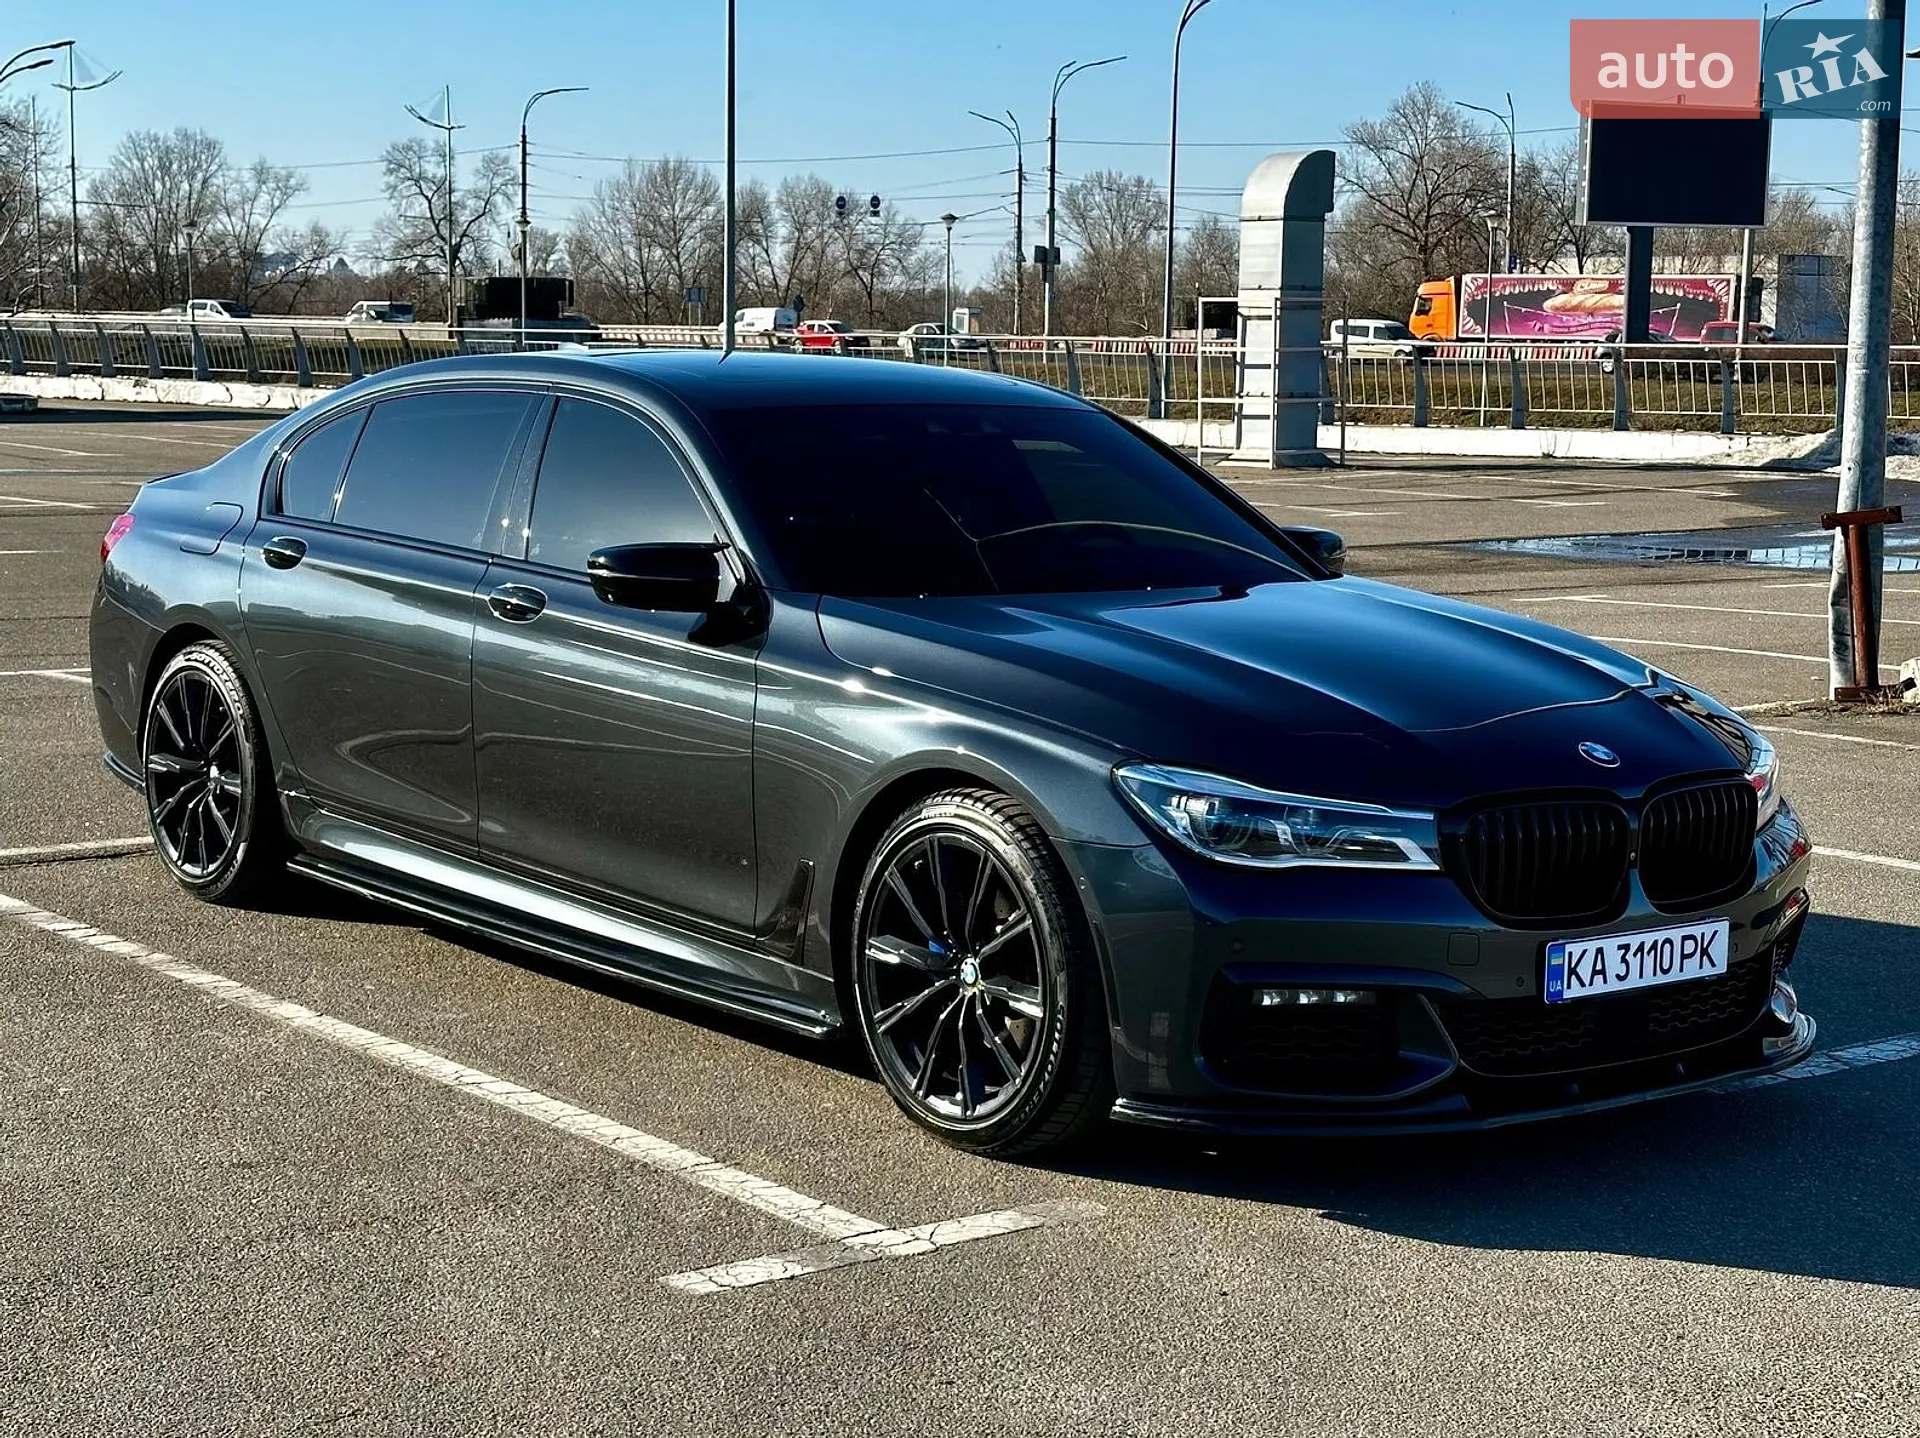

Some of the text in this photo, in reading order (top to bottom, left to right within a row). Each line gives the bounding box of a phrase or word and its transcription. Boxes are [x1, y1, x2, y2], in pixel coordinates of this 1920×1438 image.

[1566, 929, 1720, 990] KA 3110 PK
[1549, 979, 1563, 992] UA
